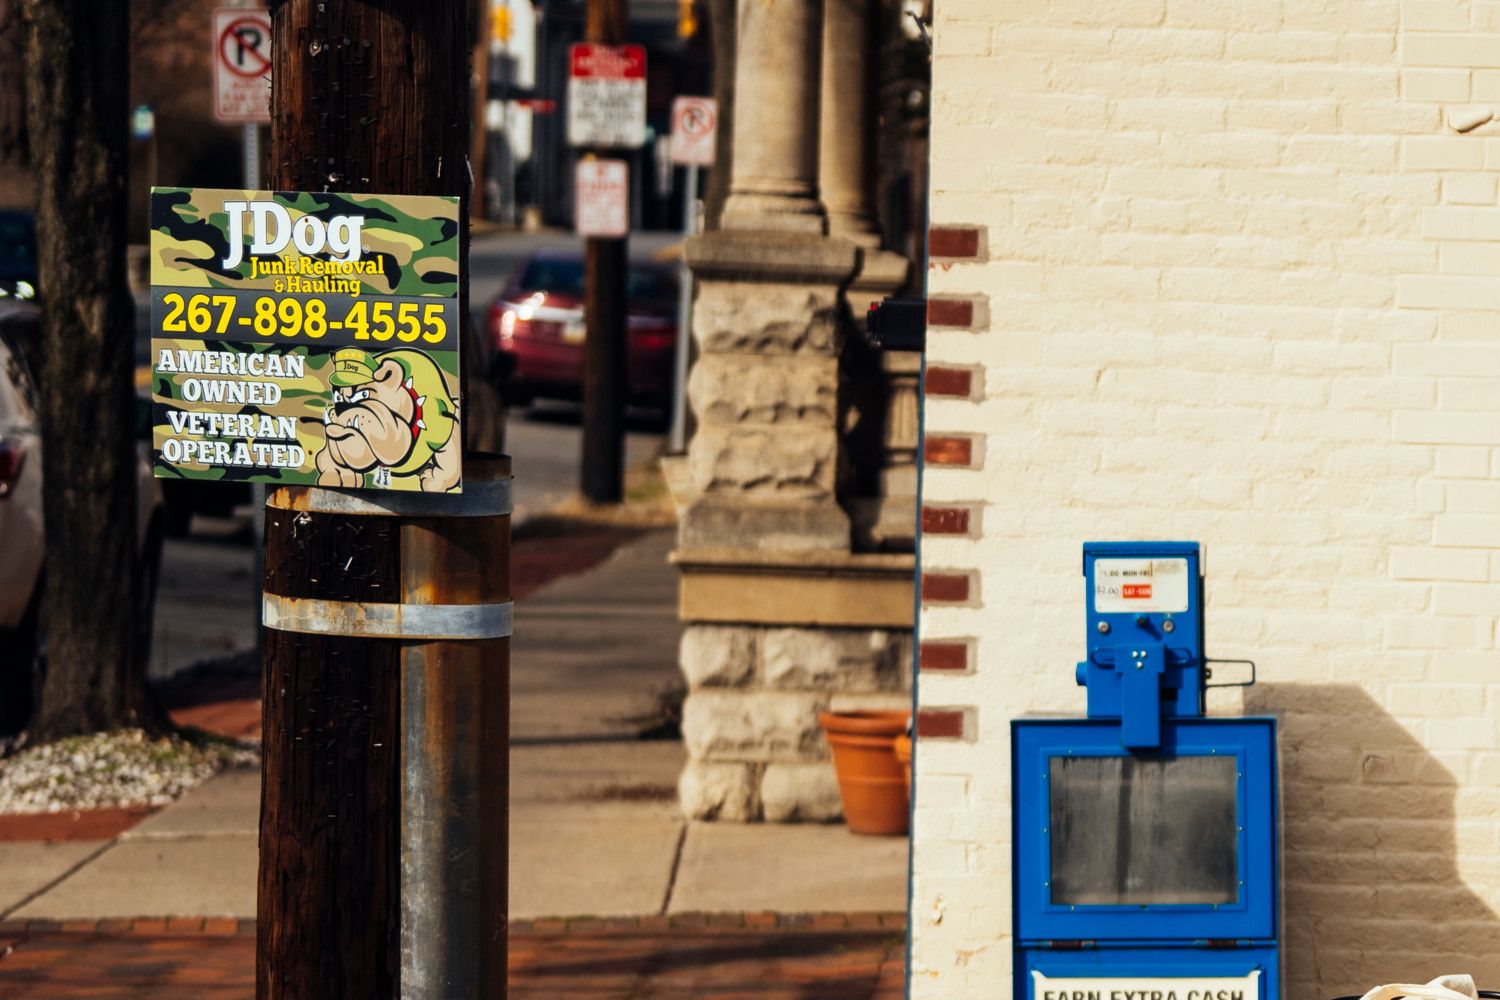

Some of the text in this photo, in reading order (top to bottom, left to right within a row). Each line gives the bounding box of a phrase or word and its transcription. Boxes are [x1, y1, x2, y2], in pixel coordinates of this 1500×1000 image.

[222, 200, 365, 270] JDog
[250, 255, 384, 280] Junk Removal
[286, 276, 361, 297] Hauling
[162, 293, 447, 343] 267-898-4555
[156, 349, 305, 378] AMERICAN
[182, 378, 282, 406] OWNED
[166, 410, 296, 439] VETERAN
[162, 438, 305, 468] OPERATED
